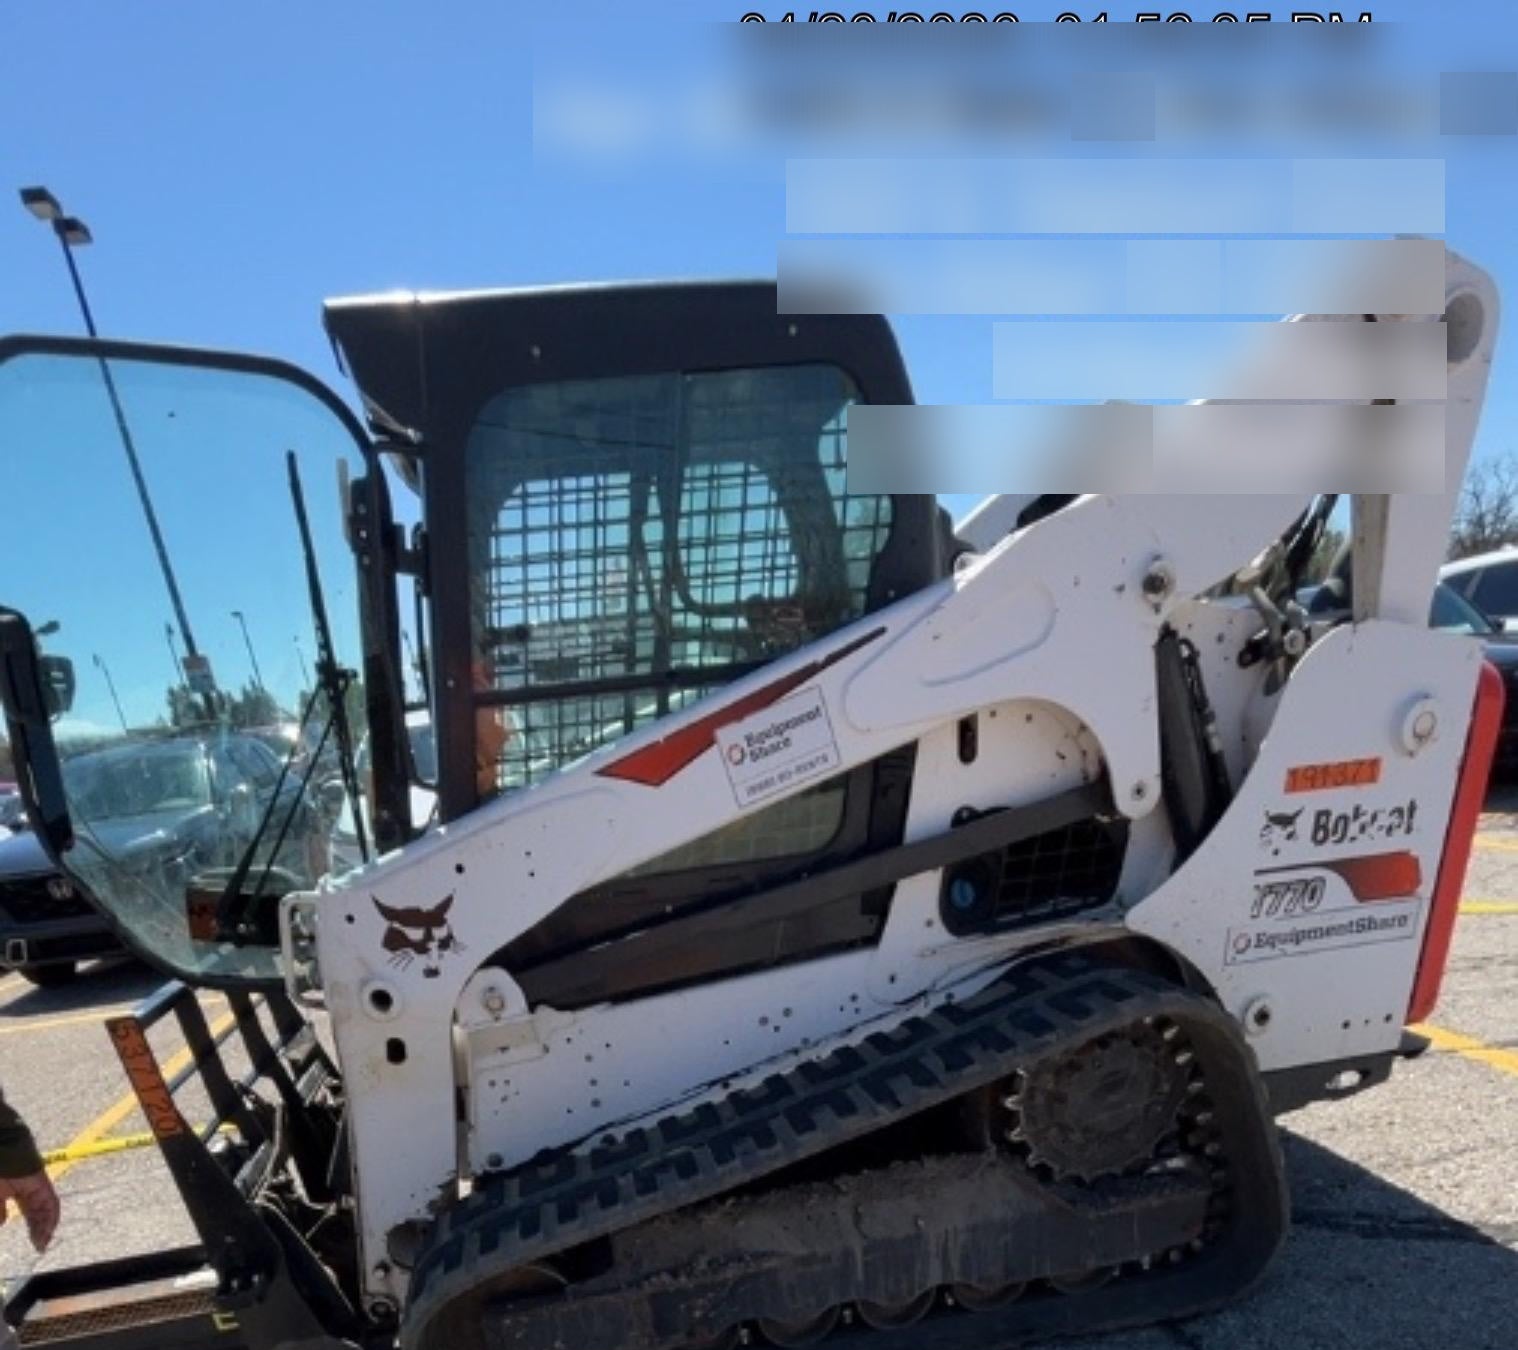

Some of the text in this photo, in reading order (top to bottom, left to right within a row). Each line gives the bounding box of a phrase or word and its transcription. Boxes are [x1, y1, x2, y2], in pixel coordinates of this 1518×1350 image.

[745, 705, 823, 748] Equipment
[749, 736, 792, 764] Share
[1253, 912, 1409, 950] EquipmentShare
